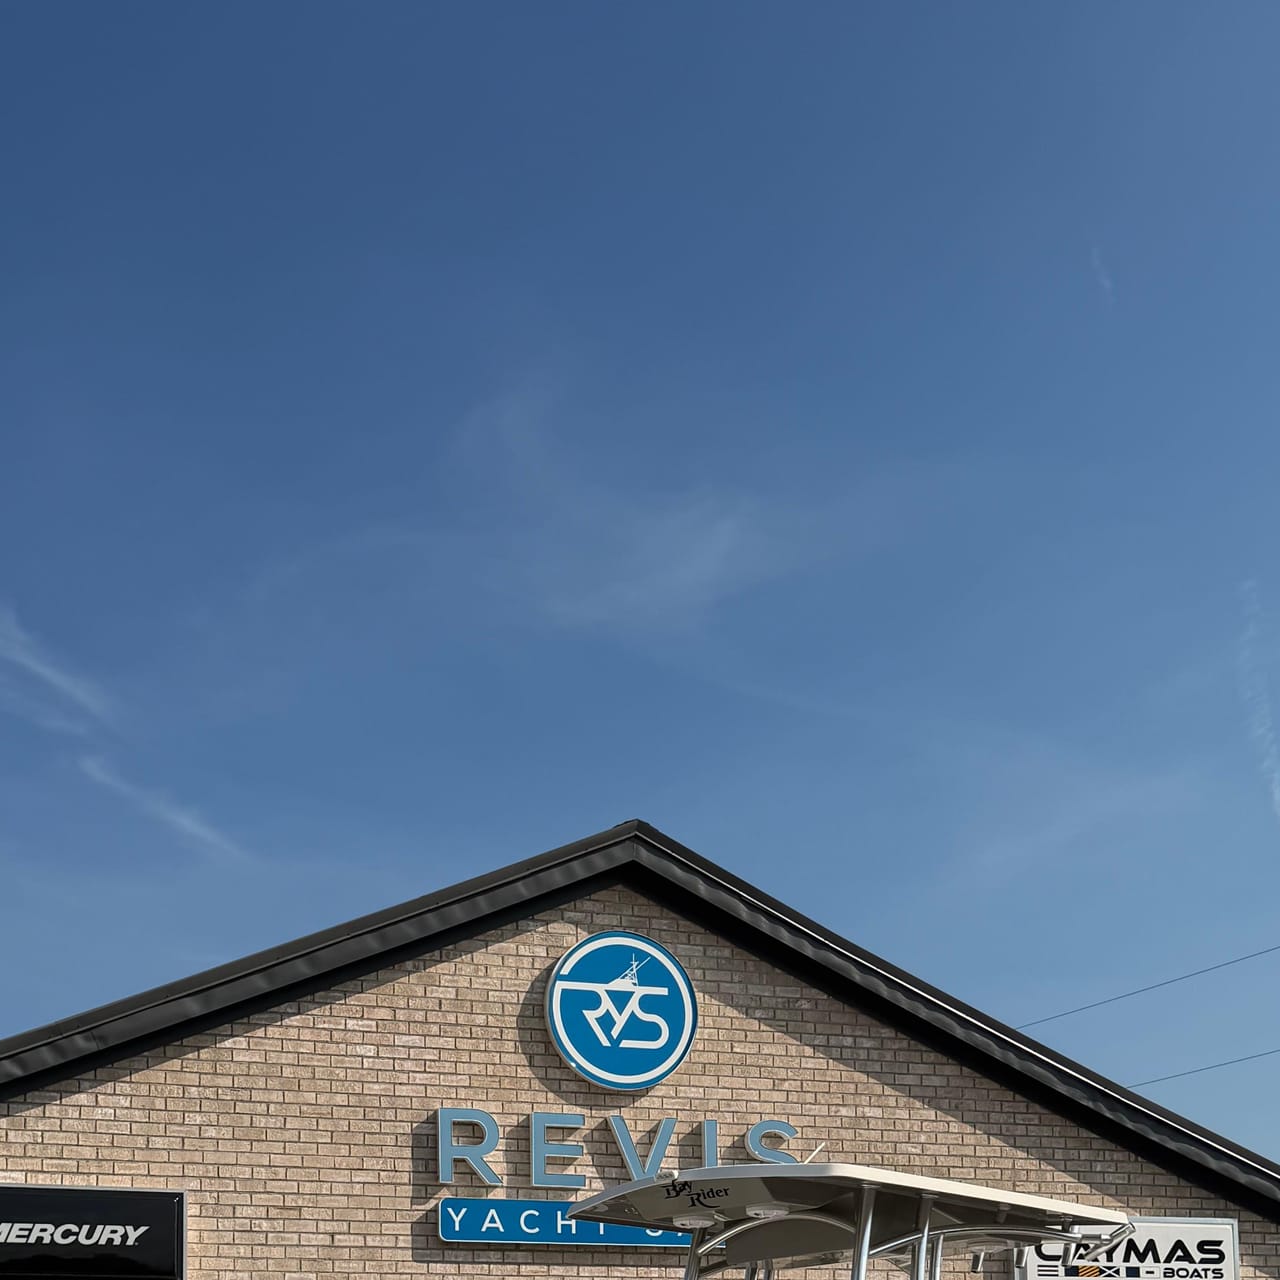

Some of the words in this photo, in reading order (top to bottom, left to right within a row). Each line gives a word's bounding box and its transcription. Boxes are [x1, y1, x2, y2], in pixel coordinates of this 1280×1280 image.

[661, 1179, 693, 1199] Bay
[683, 1187, 730, 1208] Rider
[447, 1207, 605, 1235] YACH
[1163, 1267, 1224, 1279] BOATS
